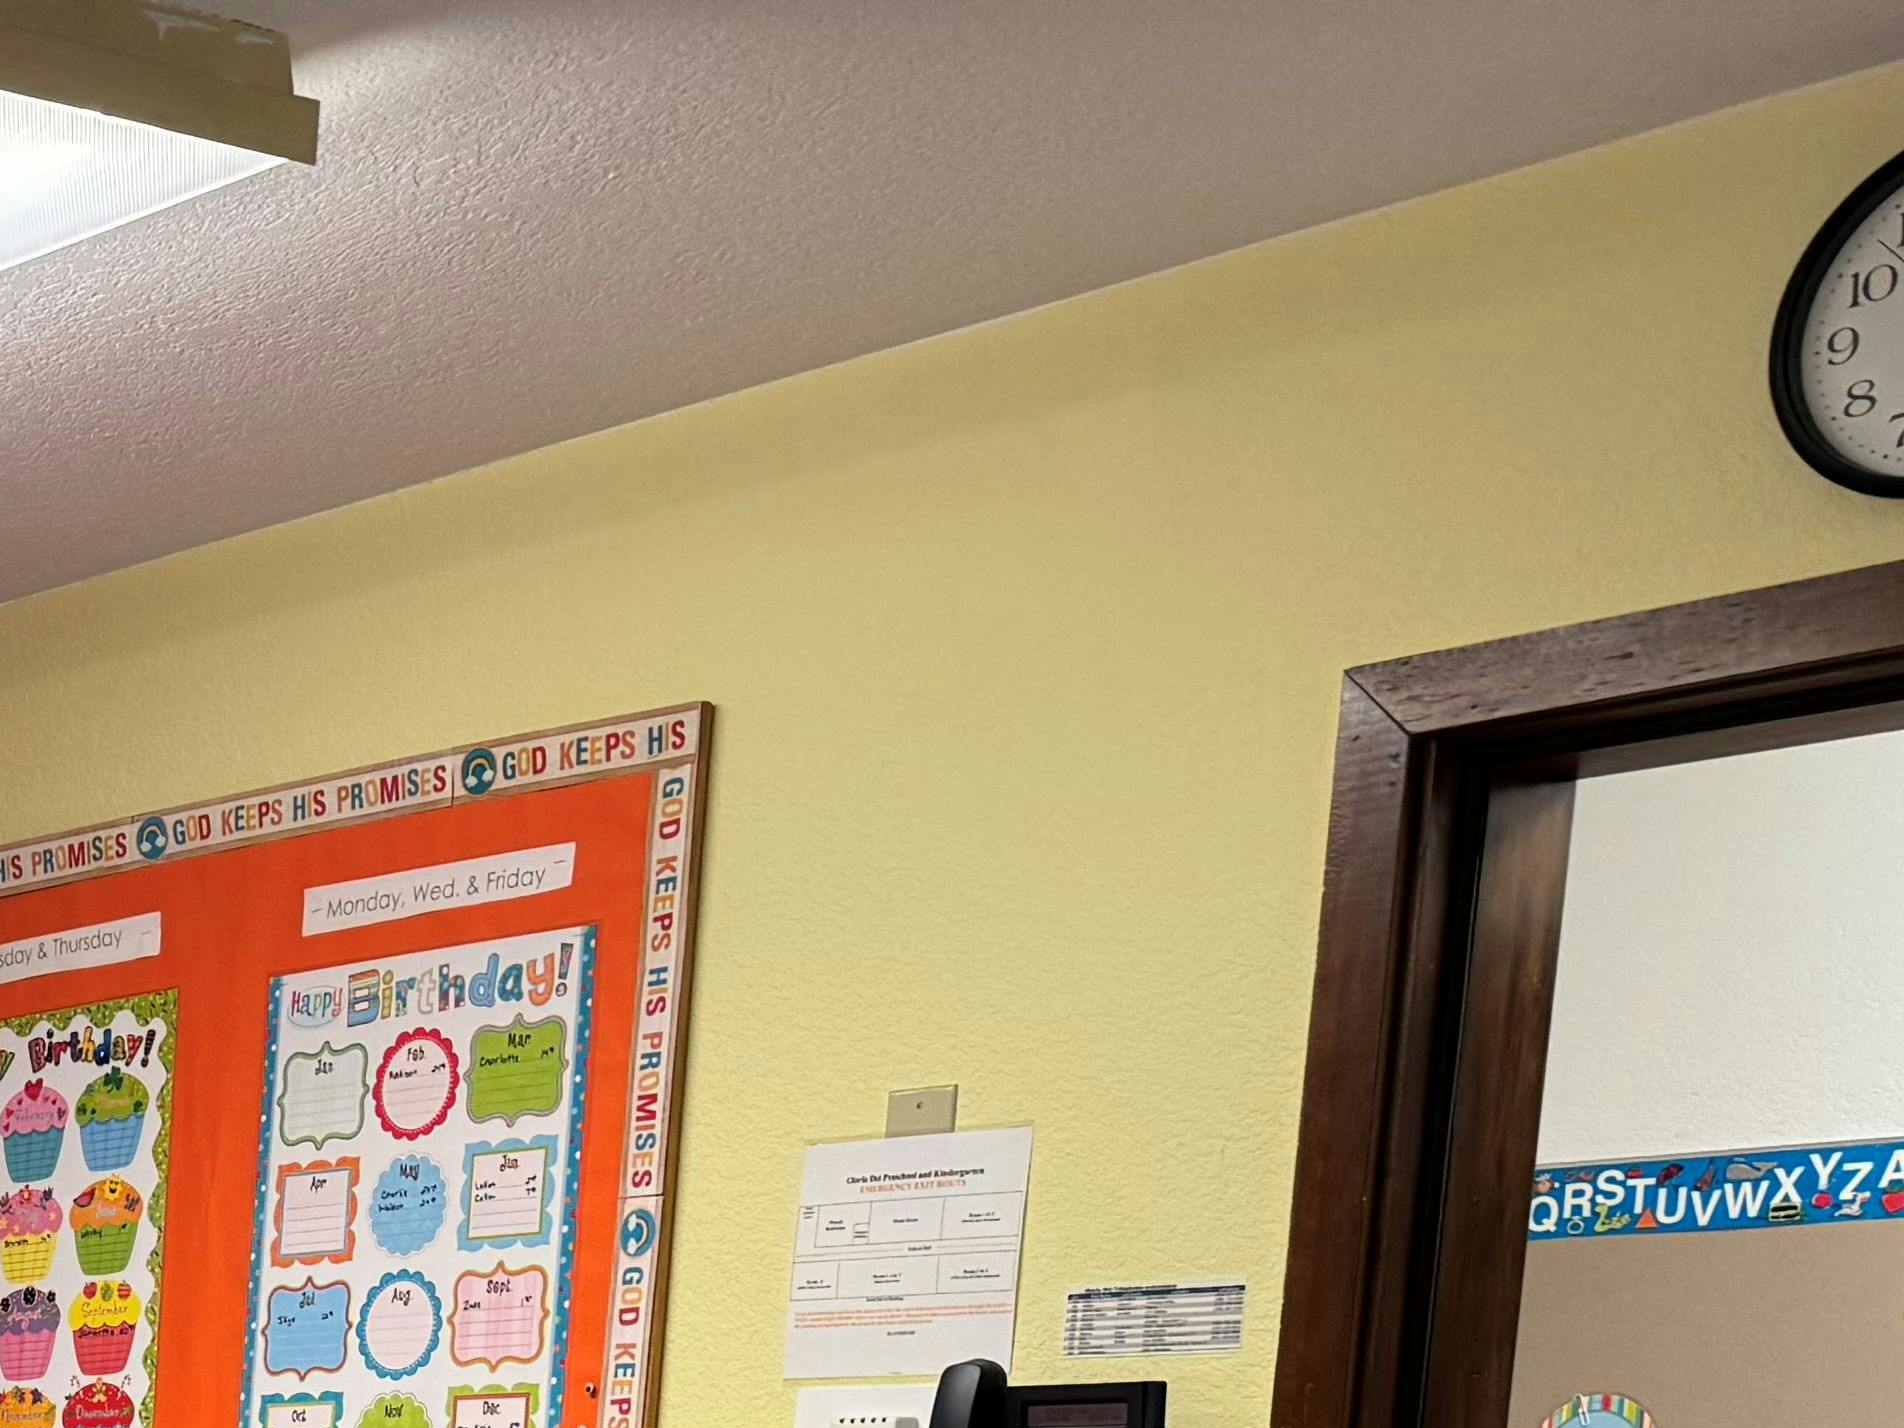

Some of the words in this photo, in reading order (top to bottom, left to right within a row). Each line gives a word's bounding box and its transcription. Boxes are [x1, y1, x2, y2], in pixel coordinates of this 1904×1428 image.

[1847, 264, 1898, 309] 10
[1827, 327, 1860, 366] 9
[1843, 379, 1877, 418] 8
[502, 745, 548, 782] GOD
[559, 731, 637, 771] KEEPS
[647, 719, 686, 756] HIS
[173, 813, 211, 847] GOD
[221, 799, 283, 837] KEEPS
[291, 790, 327, 823] HIS
[337, 764, 448, 814] PROMISES
[31, 832, 128, 877] PROMISES
[326, 888, 409, 920] Monday,
[413, 878, 461, 909] Wed.
[466, 873, 482, 897] &
[486, 863, 547, 897] Friday
[36, 938, 48, 961] &
[51, 926, 122, 961] Thursday
[291, 987, 343, 1019] Happy
[347, 943, 574, 1028] Birthday!
[28, 1026, 156, 1073] Birthday!
